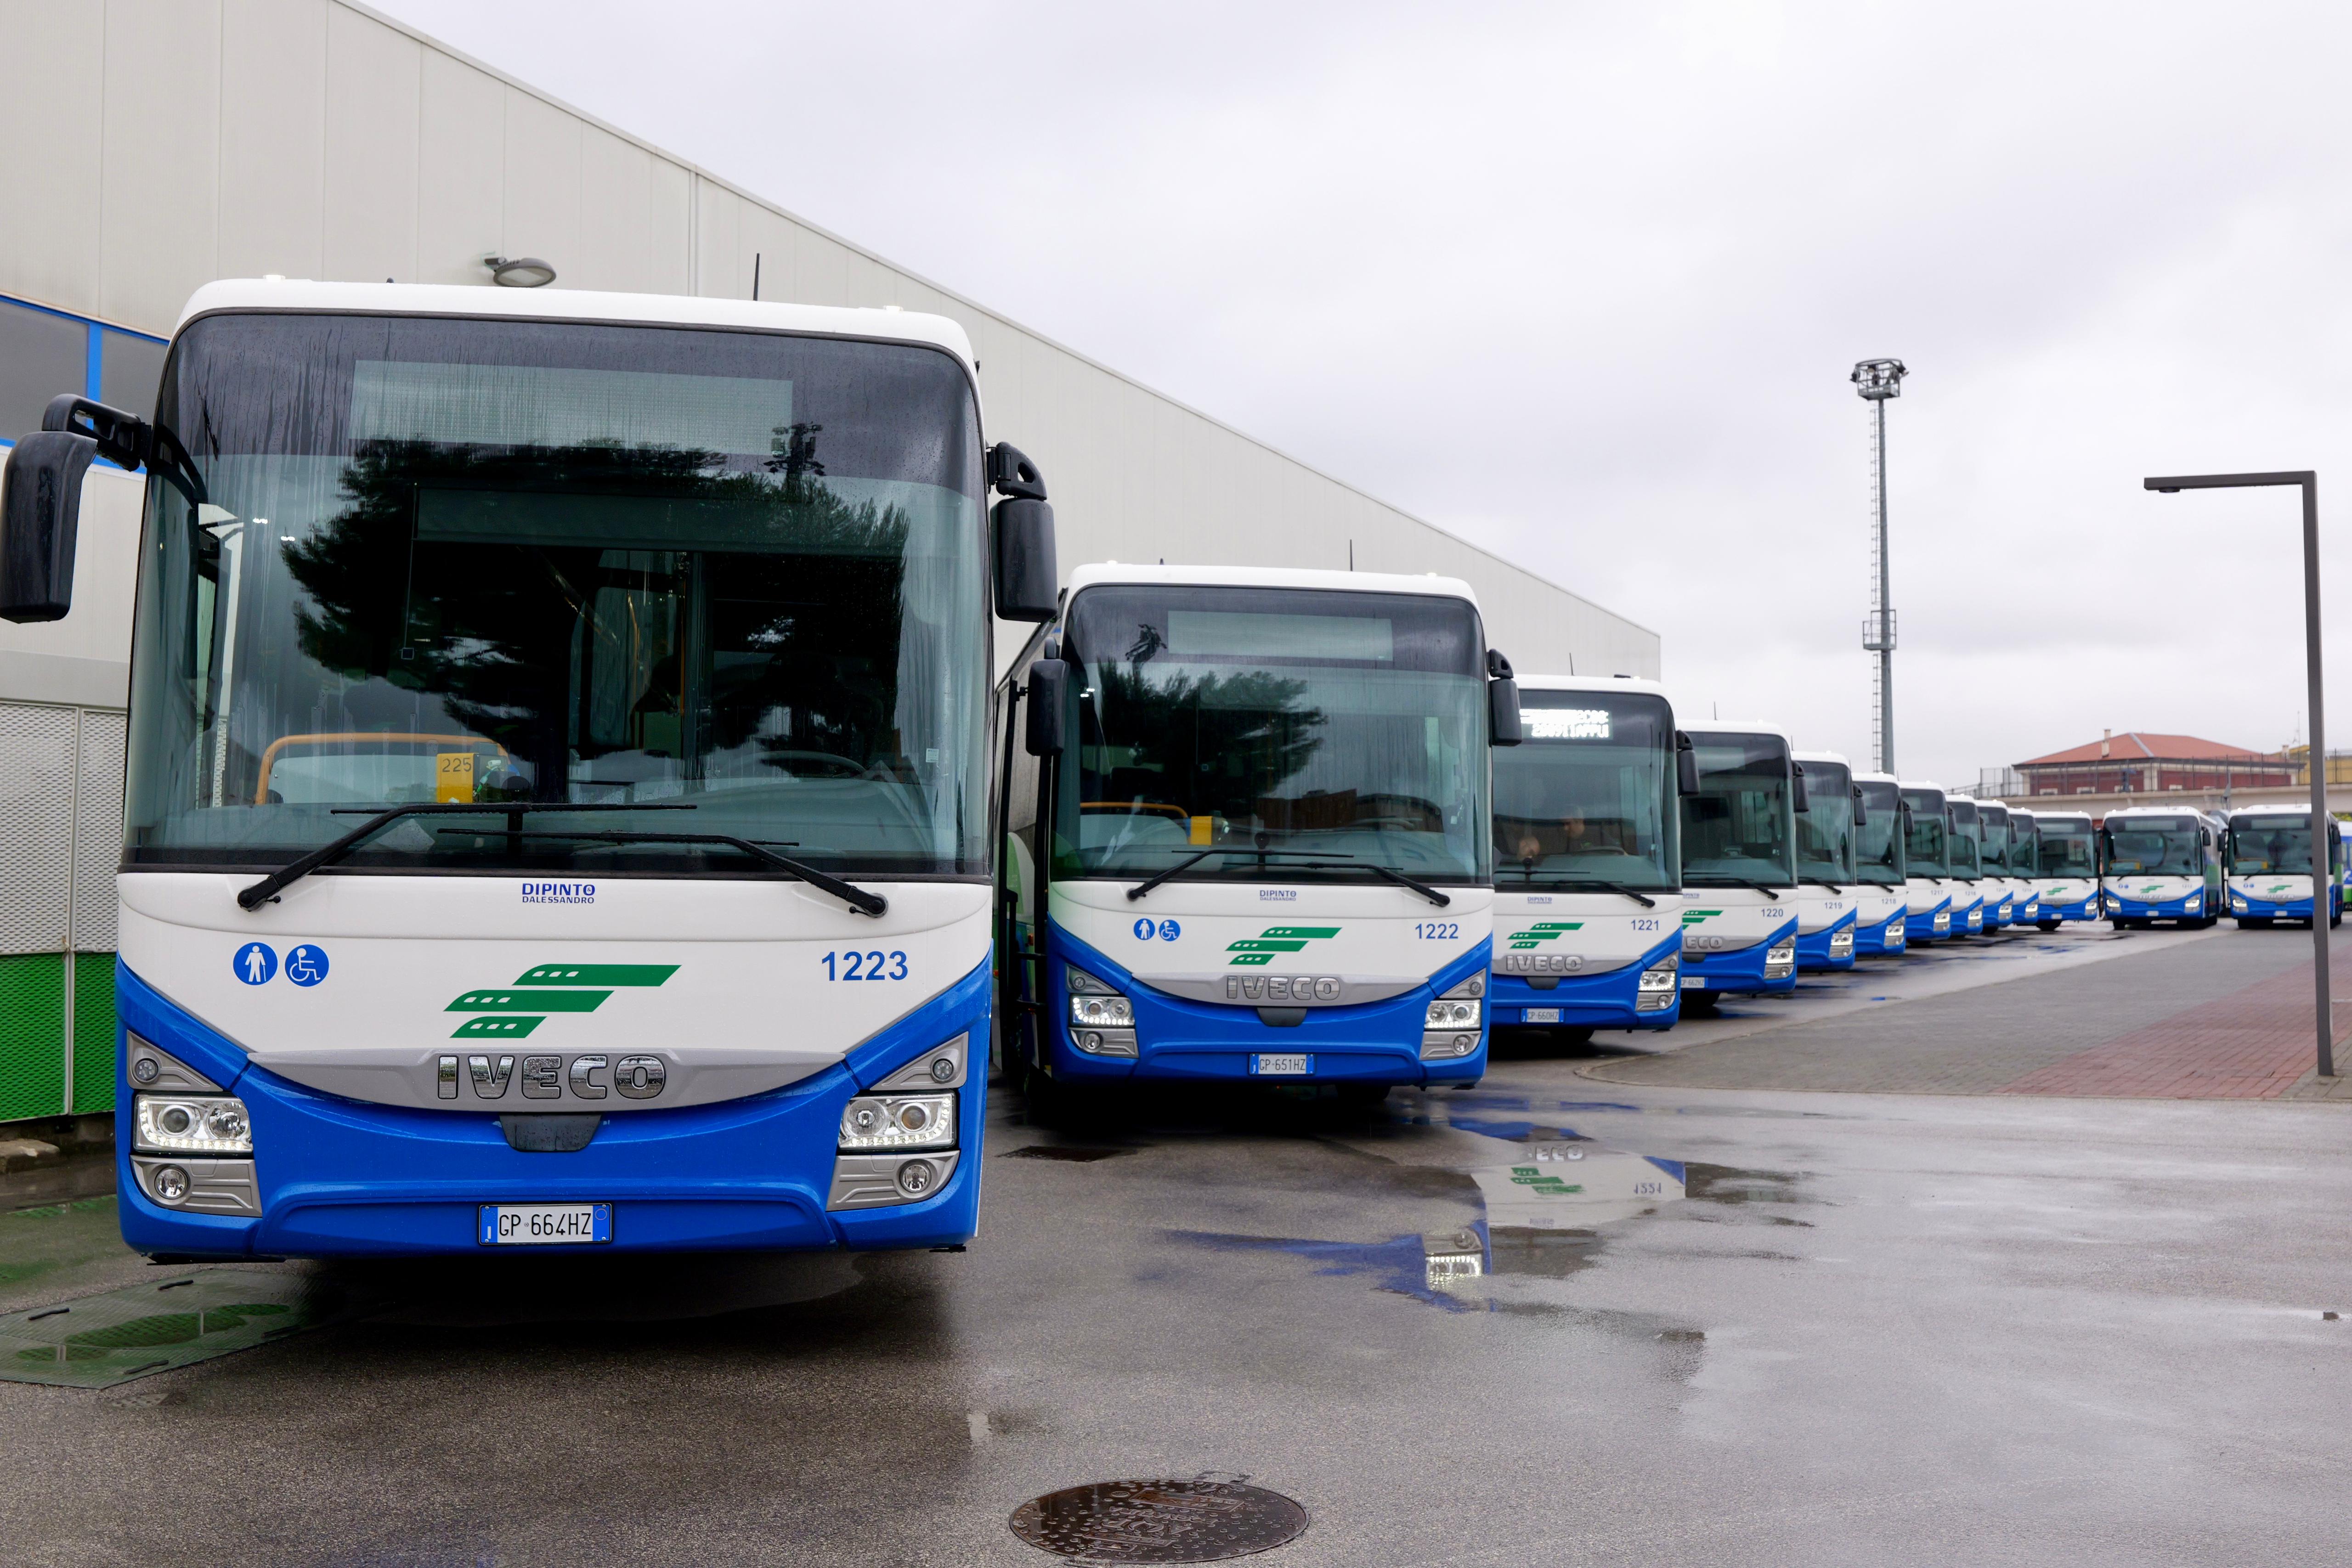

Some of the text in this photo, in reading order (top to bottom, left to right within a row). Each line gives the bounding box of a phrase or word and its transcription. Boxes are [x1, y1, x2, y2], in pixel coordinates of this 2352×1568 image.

[442, 757, 472, 773] 225
[522, 883, 595, 896] DIPINTO
[1761, 908, 1784, 917] 1220
[1415, 923, 1459, 939] 1222
[1631, 919, 1659, 931] 1221
[1685, 936, 1723, 949] ECO
[822, 951, 908, 981] 1223
[1506, 955, 1583, 972] IVECO
[1226, 976, 1341, 1001] IVECO
[1259, 1059, 1271, 1071] GP
[1275, 1058, 1306, 1071] 651HZ
[437, 1054, 666, 1100] IVECO
[499, 1214, 521, 1236] GP
[531, 1213, 592, 1235] 664HZ
